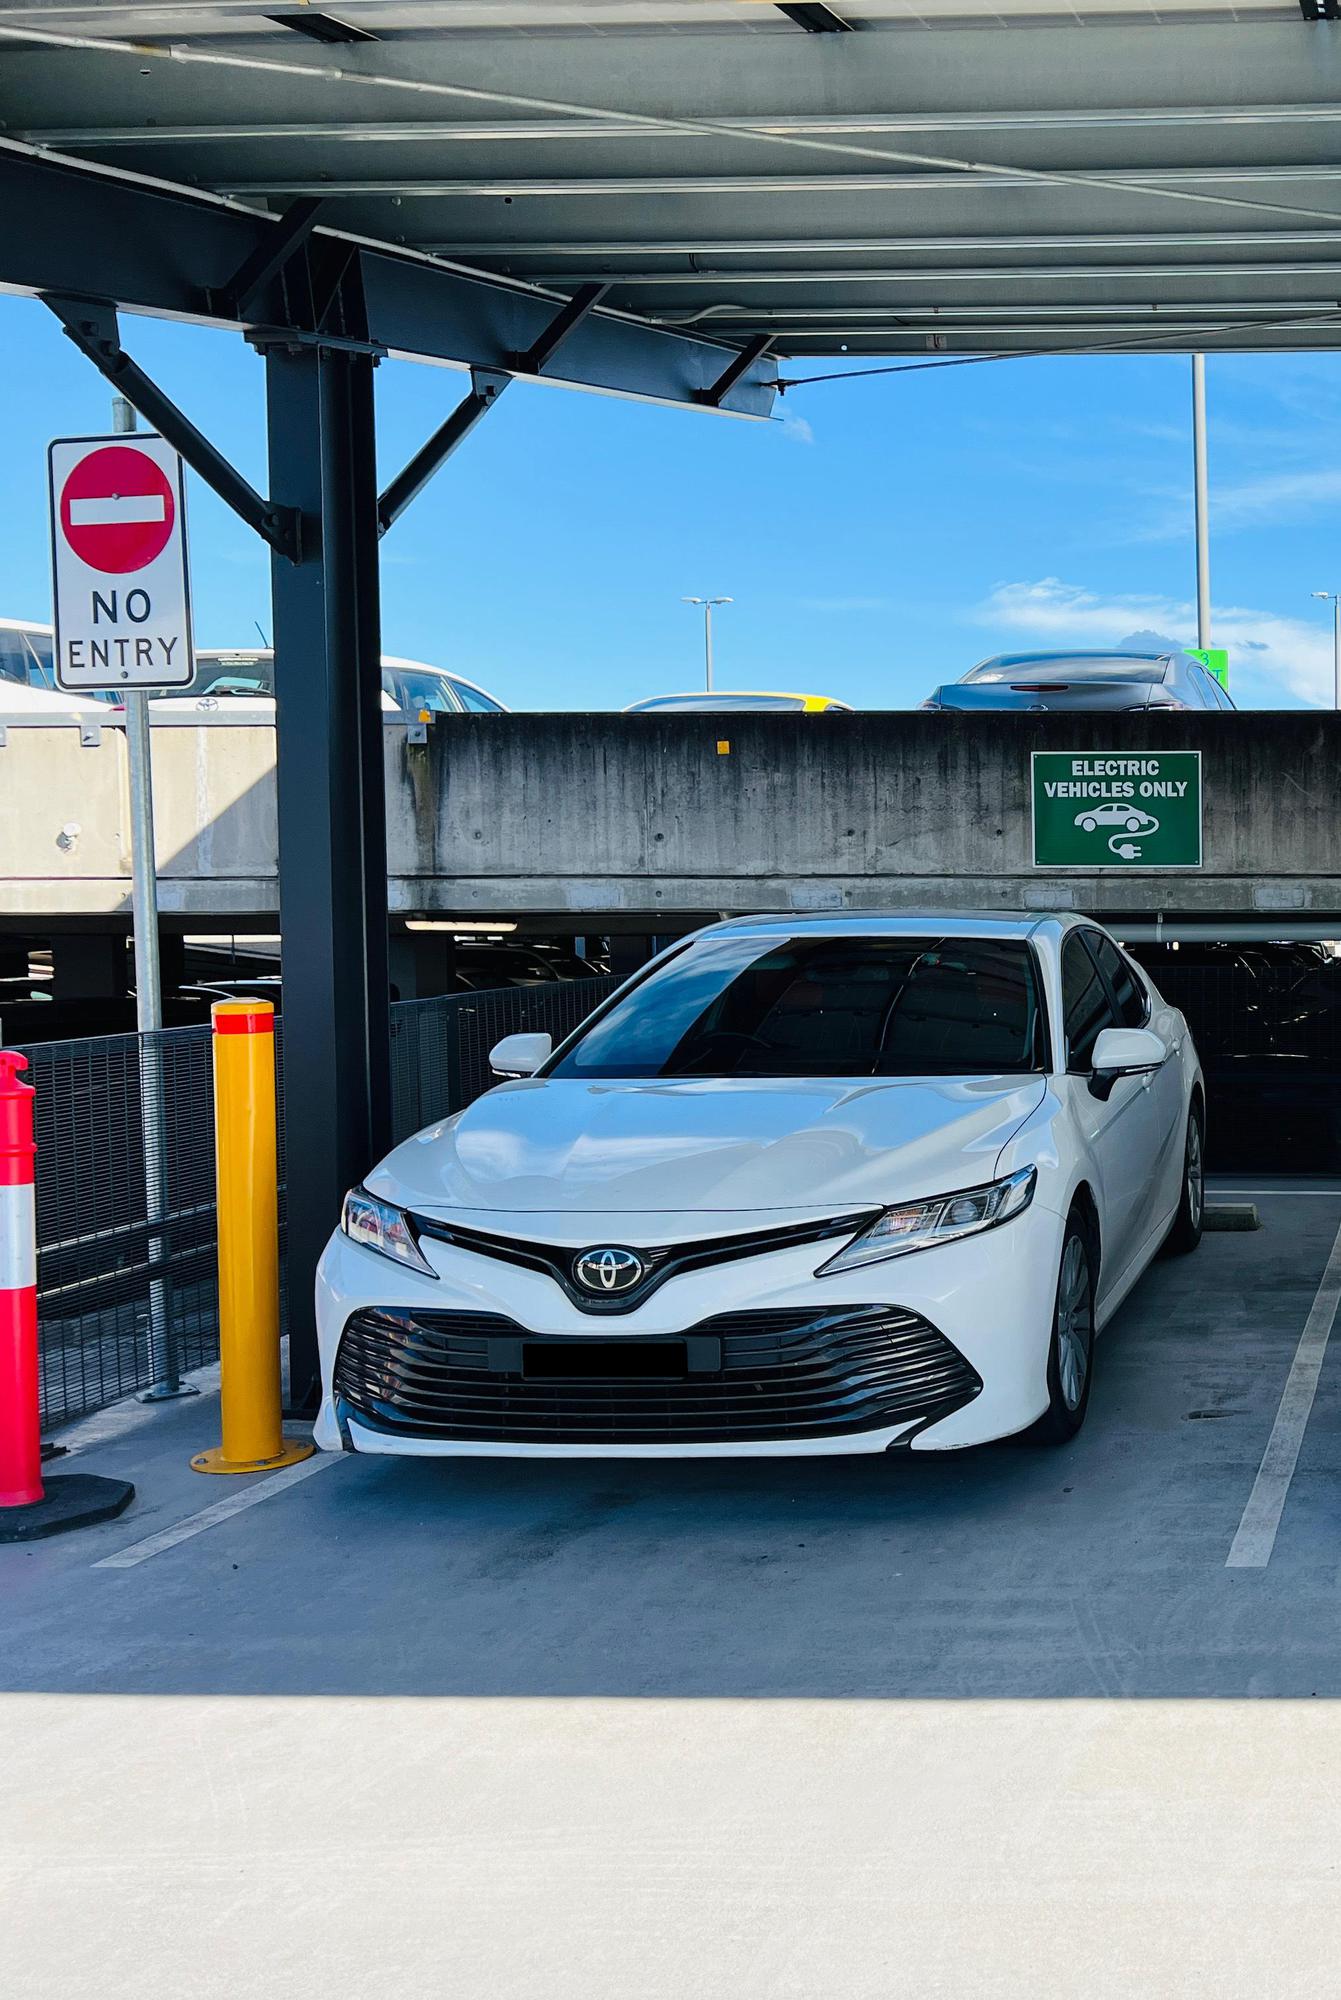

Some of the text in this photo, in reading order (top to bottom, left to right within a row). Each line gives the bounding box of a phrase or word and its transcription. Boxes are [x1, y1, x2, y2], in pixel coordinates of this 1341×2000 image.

[91, 589, 151, 624] NO
[69, 637, 178, 668] ENTRY
[1071, 760, 1159, 776] ELECTRIC
[1044, 781, 1188, 797] VEHICLES ONLY
